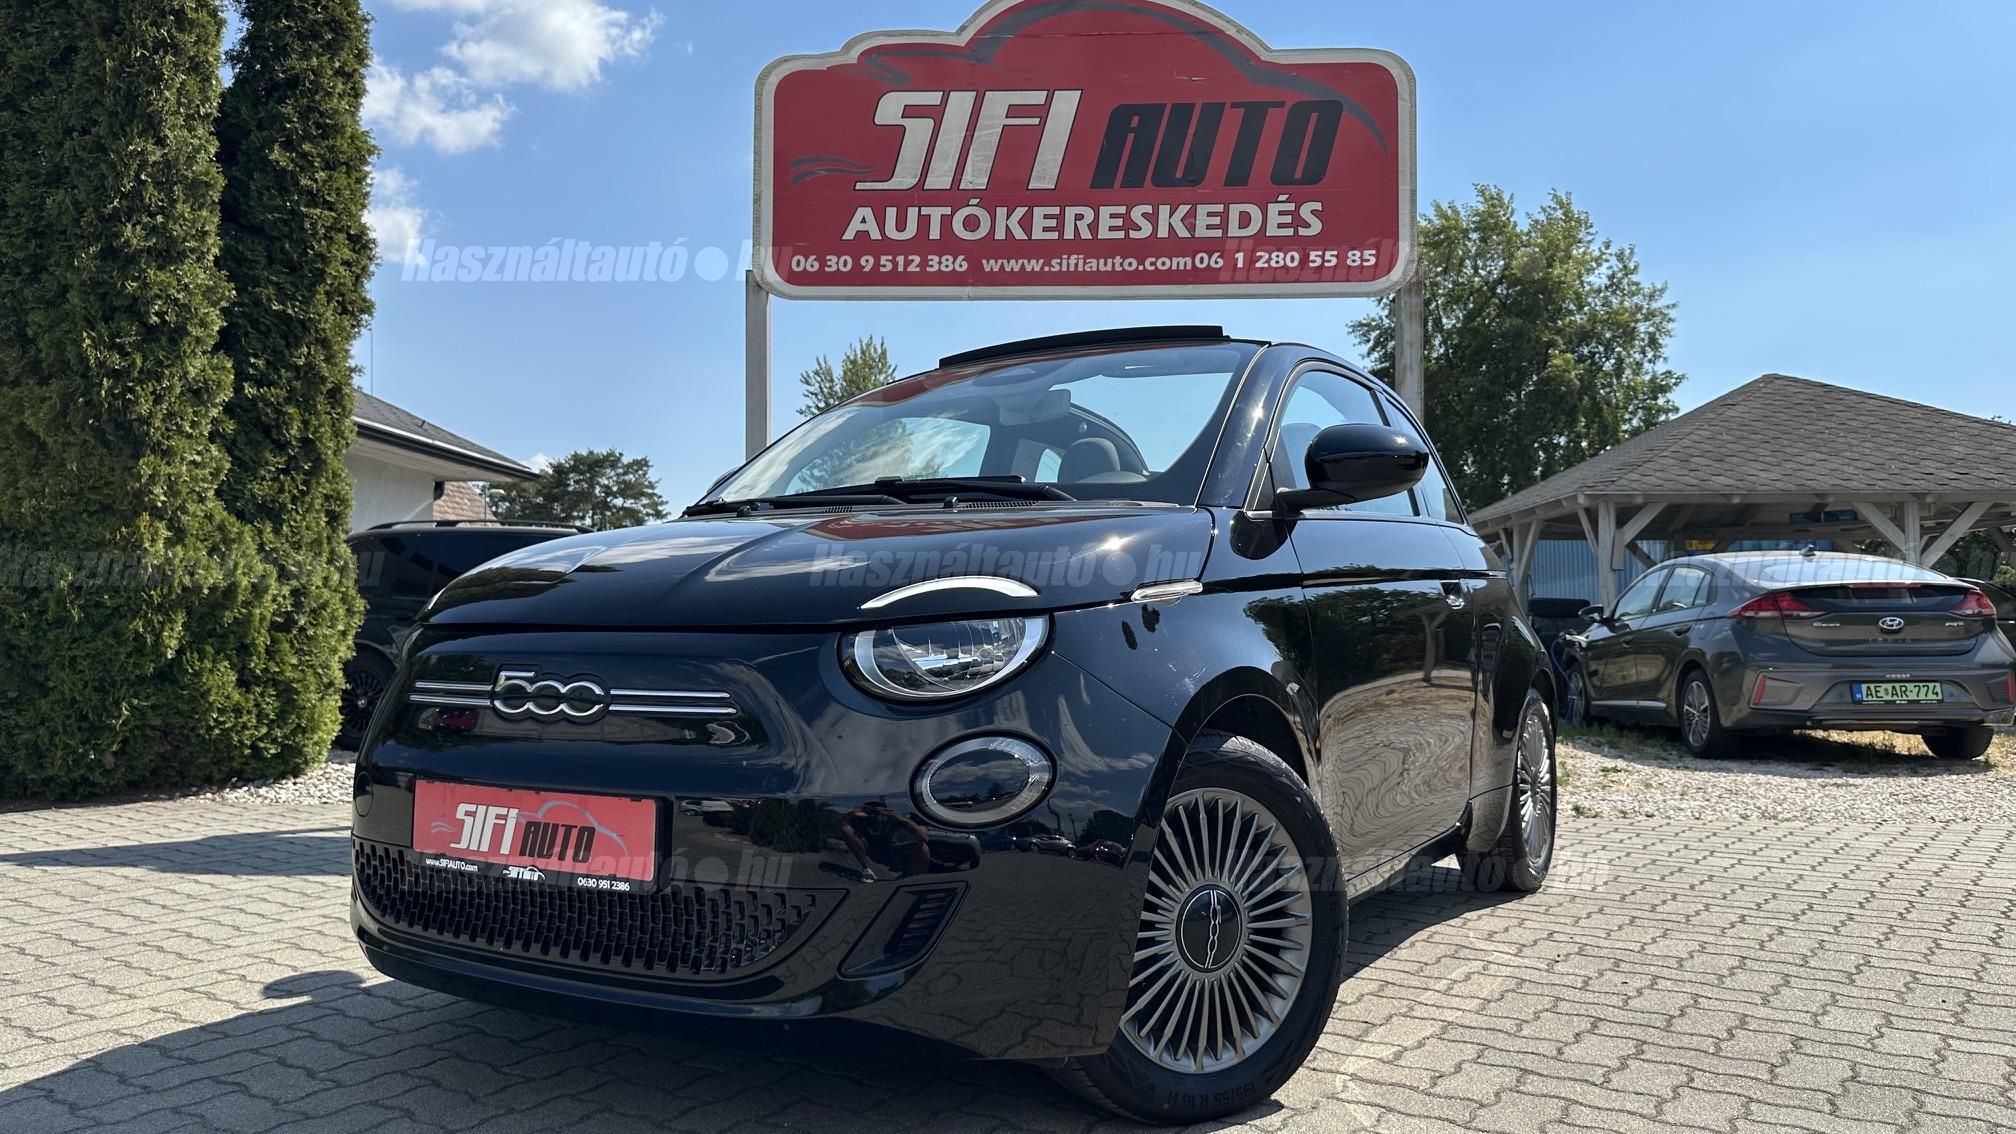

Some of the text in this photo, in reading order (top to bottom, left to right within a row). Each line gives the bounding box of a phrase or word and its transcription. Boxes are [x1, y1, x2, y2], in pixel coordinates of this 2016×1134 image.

[853, 89, 1344, 191] SIFI AUTO
[841, 195, 1323, 241] AUTÓKERESKEDÉS
[791, 255, 820, 272] 06
[824, 255, 852, 272] 30
[926, 255, 968, 272] 386
[982, 254, 1192, 273] www.sifiauto.com
[1194, 252, 1224, 269] 06
[1234, 252, 1245, 268] 1
[1255, 251, 1300, 268] 280
[1308, 250, 1338, 267] 55
[1346, 249, 1377, 267] 85
[493, 670, 605, 717] 500
[450, 802, 596, 864] SIFI AUTO
[577, 876, 630, 891] 0630 951 2386
